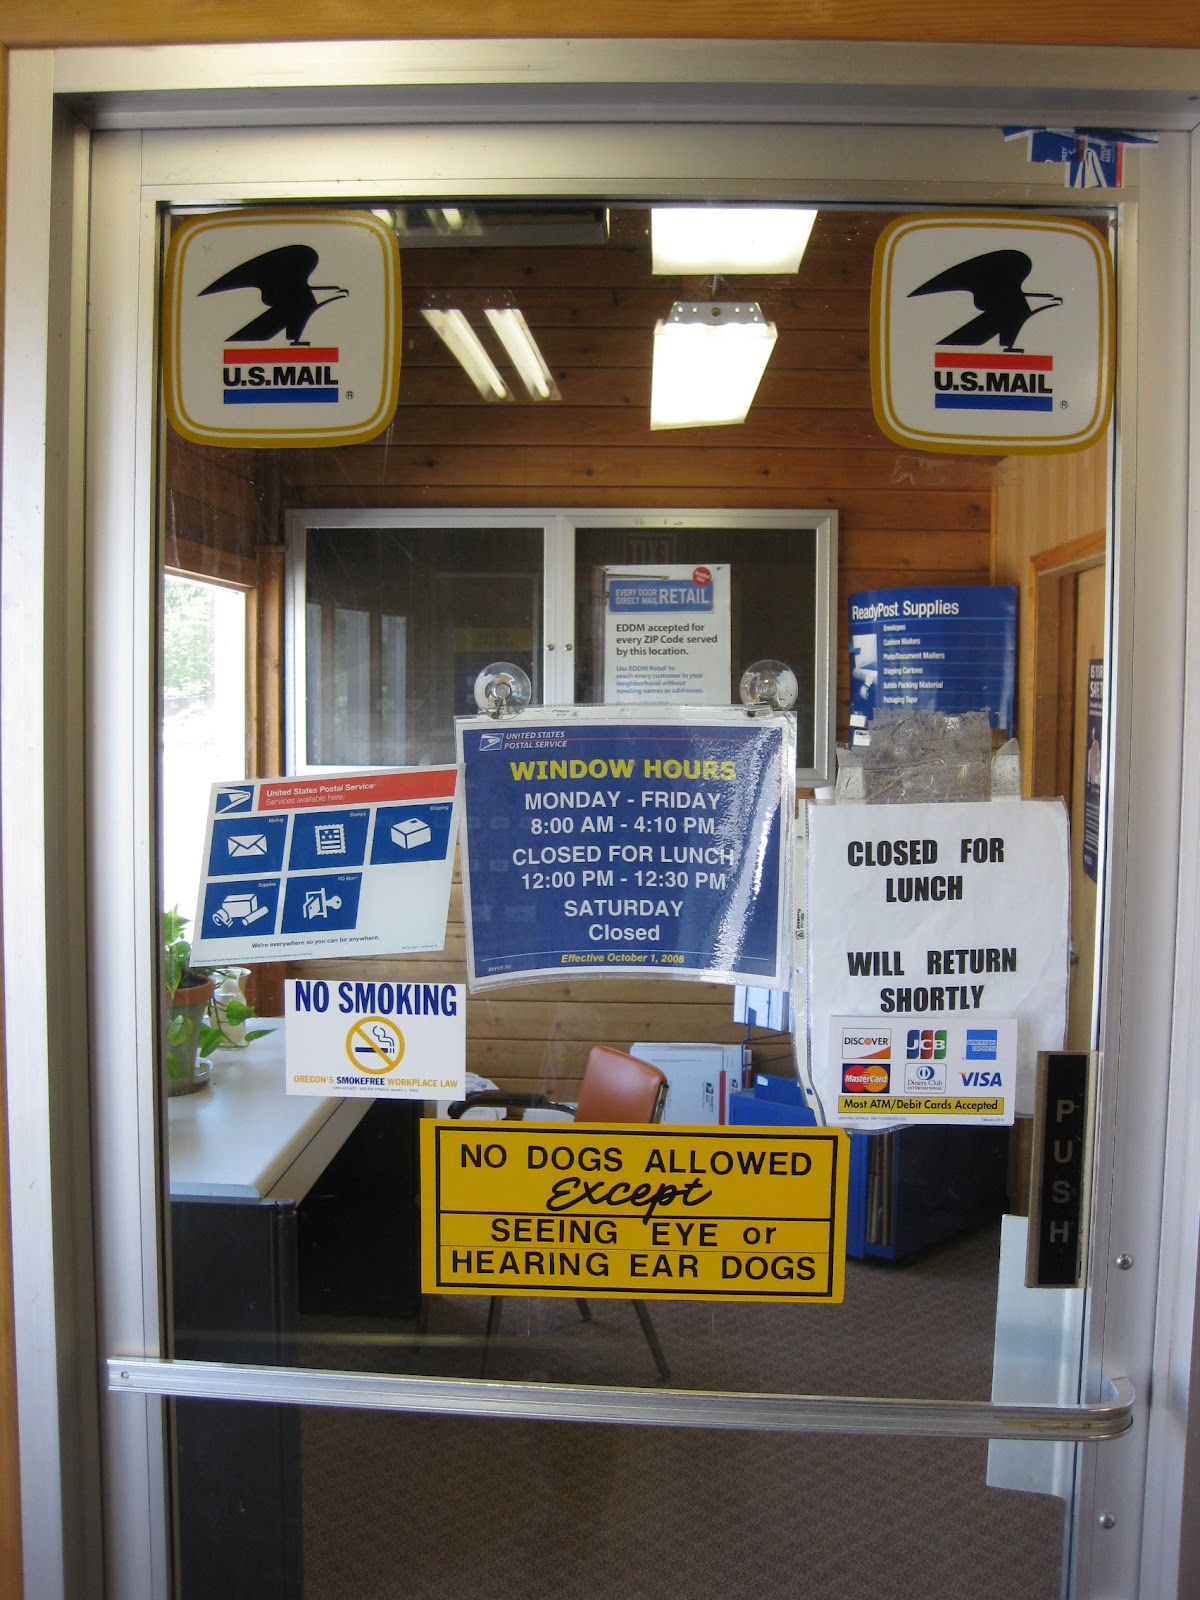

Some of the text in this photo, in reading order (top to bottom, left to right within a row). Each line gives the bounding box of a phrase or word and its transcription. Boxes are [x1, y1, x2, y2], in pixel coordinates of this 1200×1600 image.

[223, 366, 338, 387] U.S.MAIL
[934, 371, 1053, 394] U.S.MAIL
[615, 588, 657, 597] EVERY DOOR
[659, 588, 709, 604] RETAIL
[615, 597, 658, 605] DIRECT MAIL
[852, 600, 960, 621] ReadyPost Supplies
[616, 623, 705, 633] EDDM accepted for
[616, 635, 718, 645] every ZIP Code served
[901, 637, 921, 645] Mailers
[616, 647, 689, 656] by this location.
[923, 651, 945, 659] Mailers
[902, 666, 923, 675] Cartons
[897, 681, 918, 691] Packing
[918, 680, 944, 689] Material
[505, 731, 565, 740] UNITED STATES
[504, 740, 567, 749] POSTAL SERVICE
[510, 759, 737, 781] WINDOW HOURS
[266, 788, 292, 797] United
[293, 786, 318, 795] States
[319, 784, 344, 793] Postal
[266, 793, 345, 806] Services available here:
[525, 791, 621, 810] MONDAY
[640, 791, 721, 810] FRIDAY
[530, 817, 574, 834] 8:00
[580, 816, 613, 833] AM
[633, 817, 677, 833] 4:10
[683, 817, 715, 834] PM
[512, 846, 734, 865] CLOSED FOR LUNCH
[847, 837, 1004, 866] CLOSED FOR
[521, 872, 576, 889] 12:00
[582, 871, 613, 887] PM
[635, 871, 689, 888] 12:30
[695, 872, 726, 890] PM
[886, 875, 963, 903] LUNCH
[564, 900, 684, 917] SATURDAY
[588, 925, 660, 941] Closed
[269, 940, 305, 948] everywhere
[314, 939, 326, 947] you
[348, 935, 380, 943] anywhere.
[561, 954, 684, 965] Effective October 1, 2008
[847, 948, 1017, 976] WILL RETURN
[295, 981, 457, 1017] NO SMOKING
[880, 985, 984, 1013] SHORTLY
[844, 1036, 889, 1047] DISCOVER
[907, 1039, 946, 1050] JCB
[293, 1075, 458, 1088] OREGON'S SMOKEFREE WORKPLACE LAW
[844, 1073, 888, 1085] MasterCard
[960, 1072, 1002, 1087] VISA
[844, 1099, 998, 1112] Most ATM/Debit Cards Accepted
[461, 1143, 812, 1176] NO DOGS ALLOWED
[1050, 1100, 1075, 1243] PUSH
[546, 1177, 712, 1225] Except
[491, 1218, 776, 1247] SEEING EYE or
[451, 1250, 816, 1281] HEARING EAR DOGS
